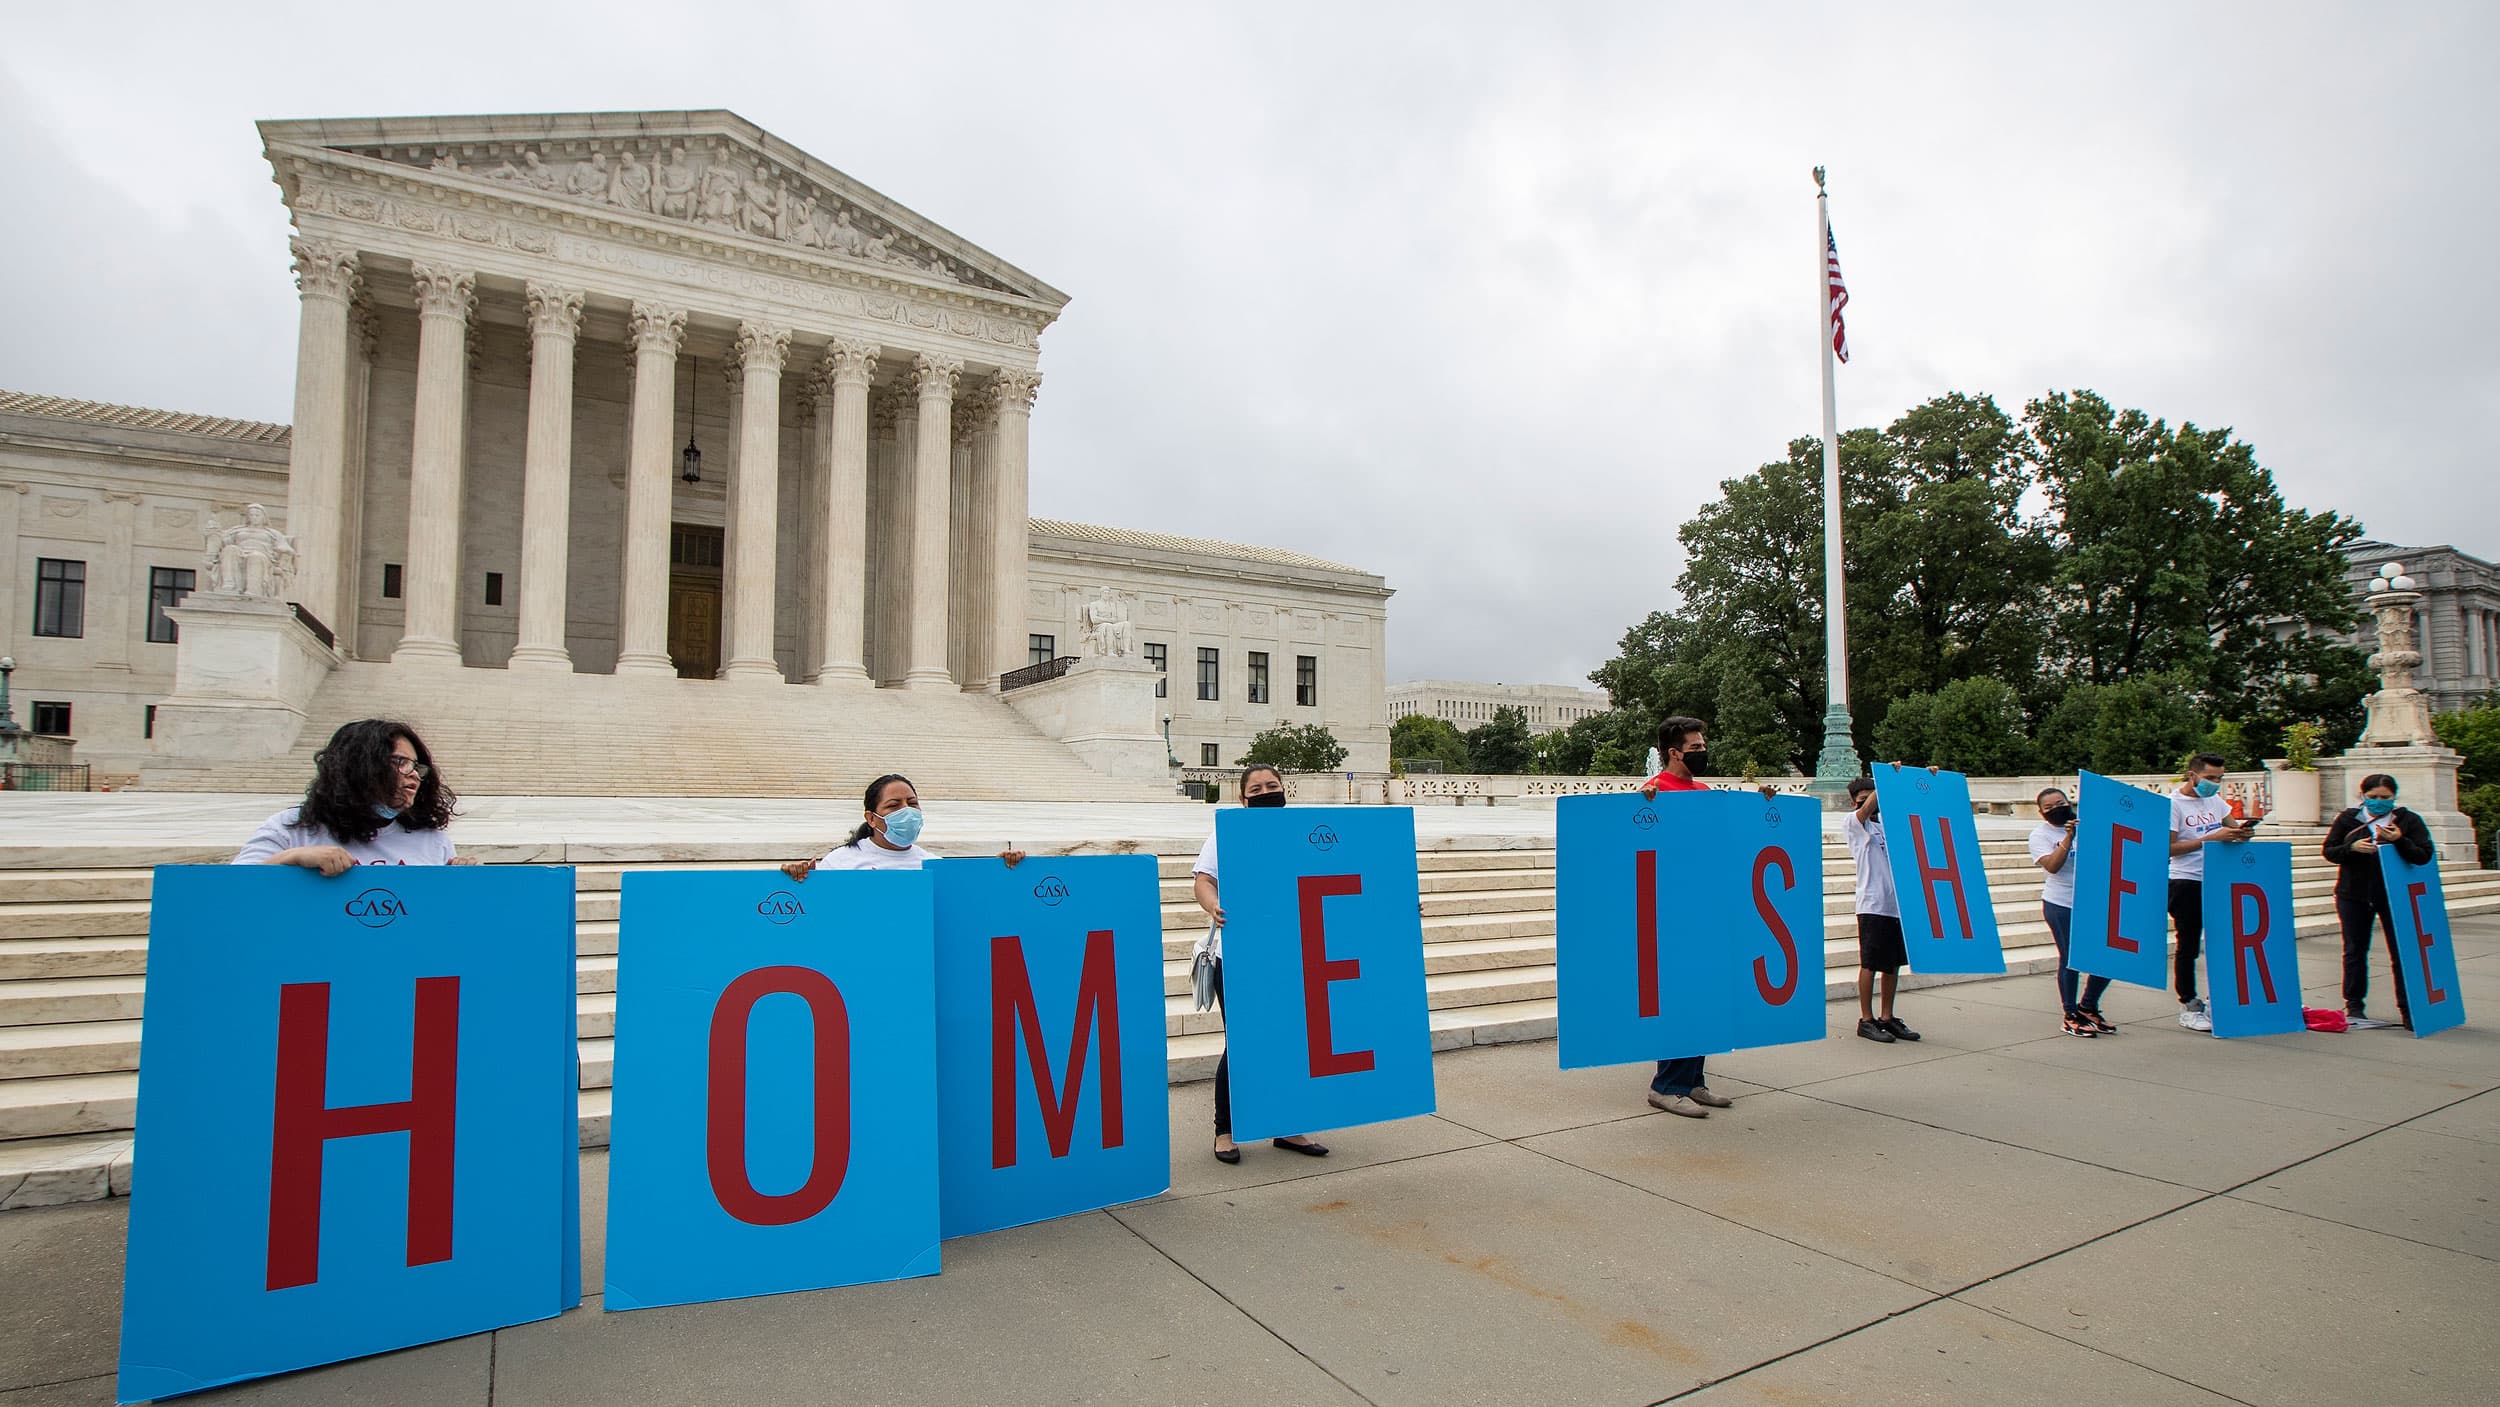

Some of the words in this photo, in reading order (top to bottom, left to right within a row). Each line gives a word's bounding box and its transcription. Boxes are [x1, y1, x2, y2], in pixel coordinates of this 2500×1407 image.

[573, 240, 642, 269] EQUAL
[654, 259, 730, 286] JUSTICE
[740, 272, 804, 299] UNDER
[810, 288, 848, 306] LAW
[1309, 832, 1339, 844] CASA
[1633, 814, 1659, 824] CASA
[1910, 815, 1973, 939] H
[345, 900, 408, 916] CASA
[758, 901, 806, 915] CASA
[1034, 885, 1070, 898] CASA
[1636, 850, 1659, 1018] I
[1752, 846, 1798, 1006] S
[2107, 823, 2142, 953] E
[2231, 883, 2277, 1005] R
[2408, 882, 2446, 1004] E
[1297, 874, 1375, 1078] E
[707, 966, 850, 1226] O
[991, 930, 1124, 1169] M
[266, 976, 460, 1291] H
